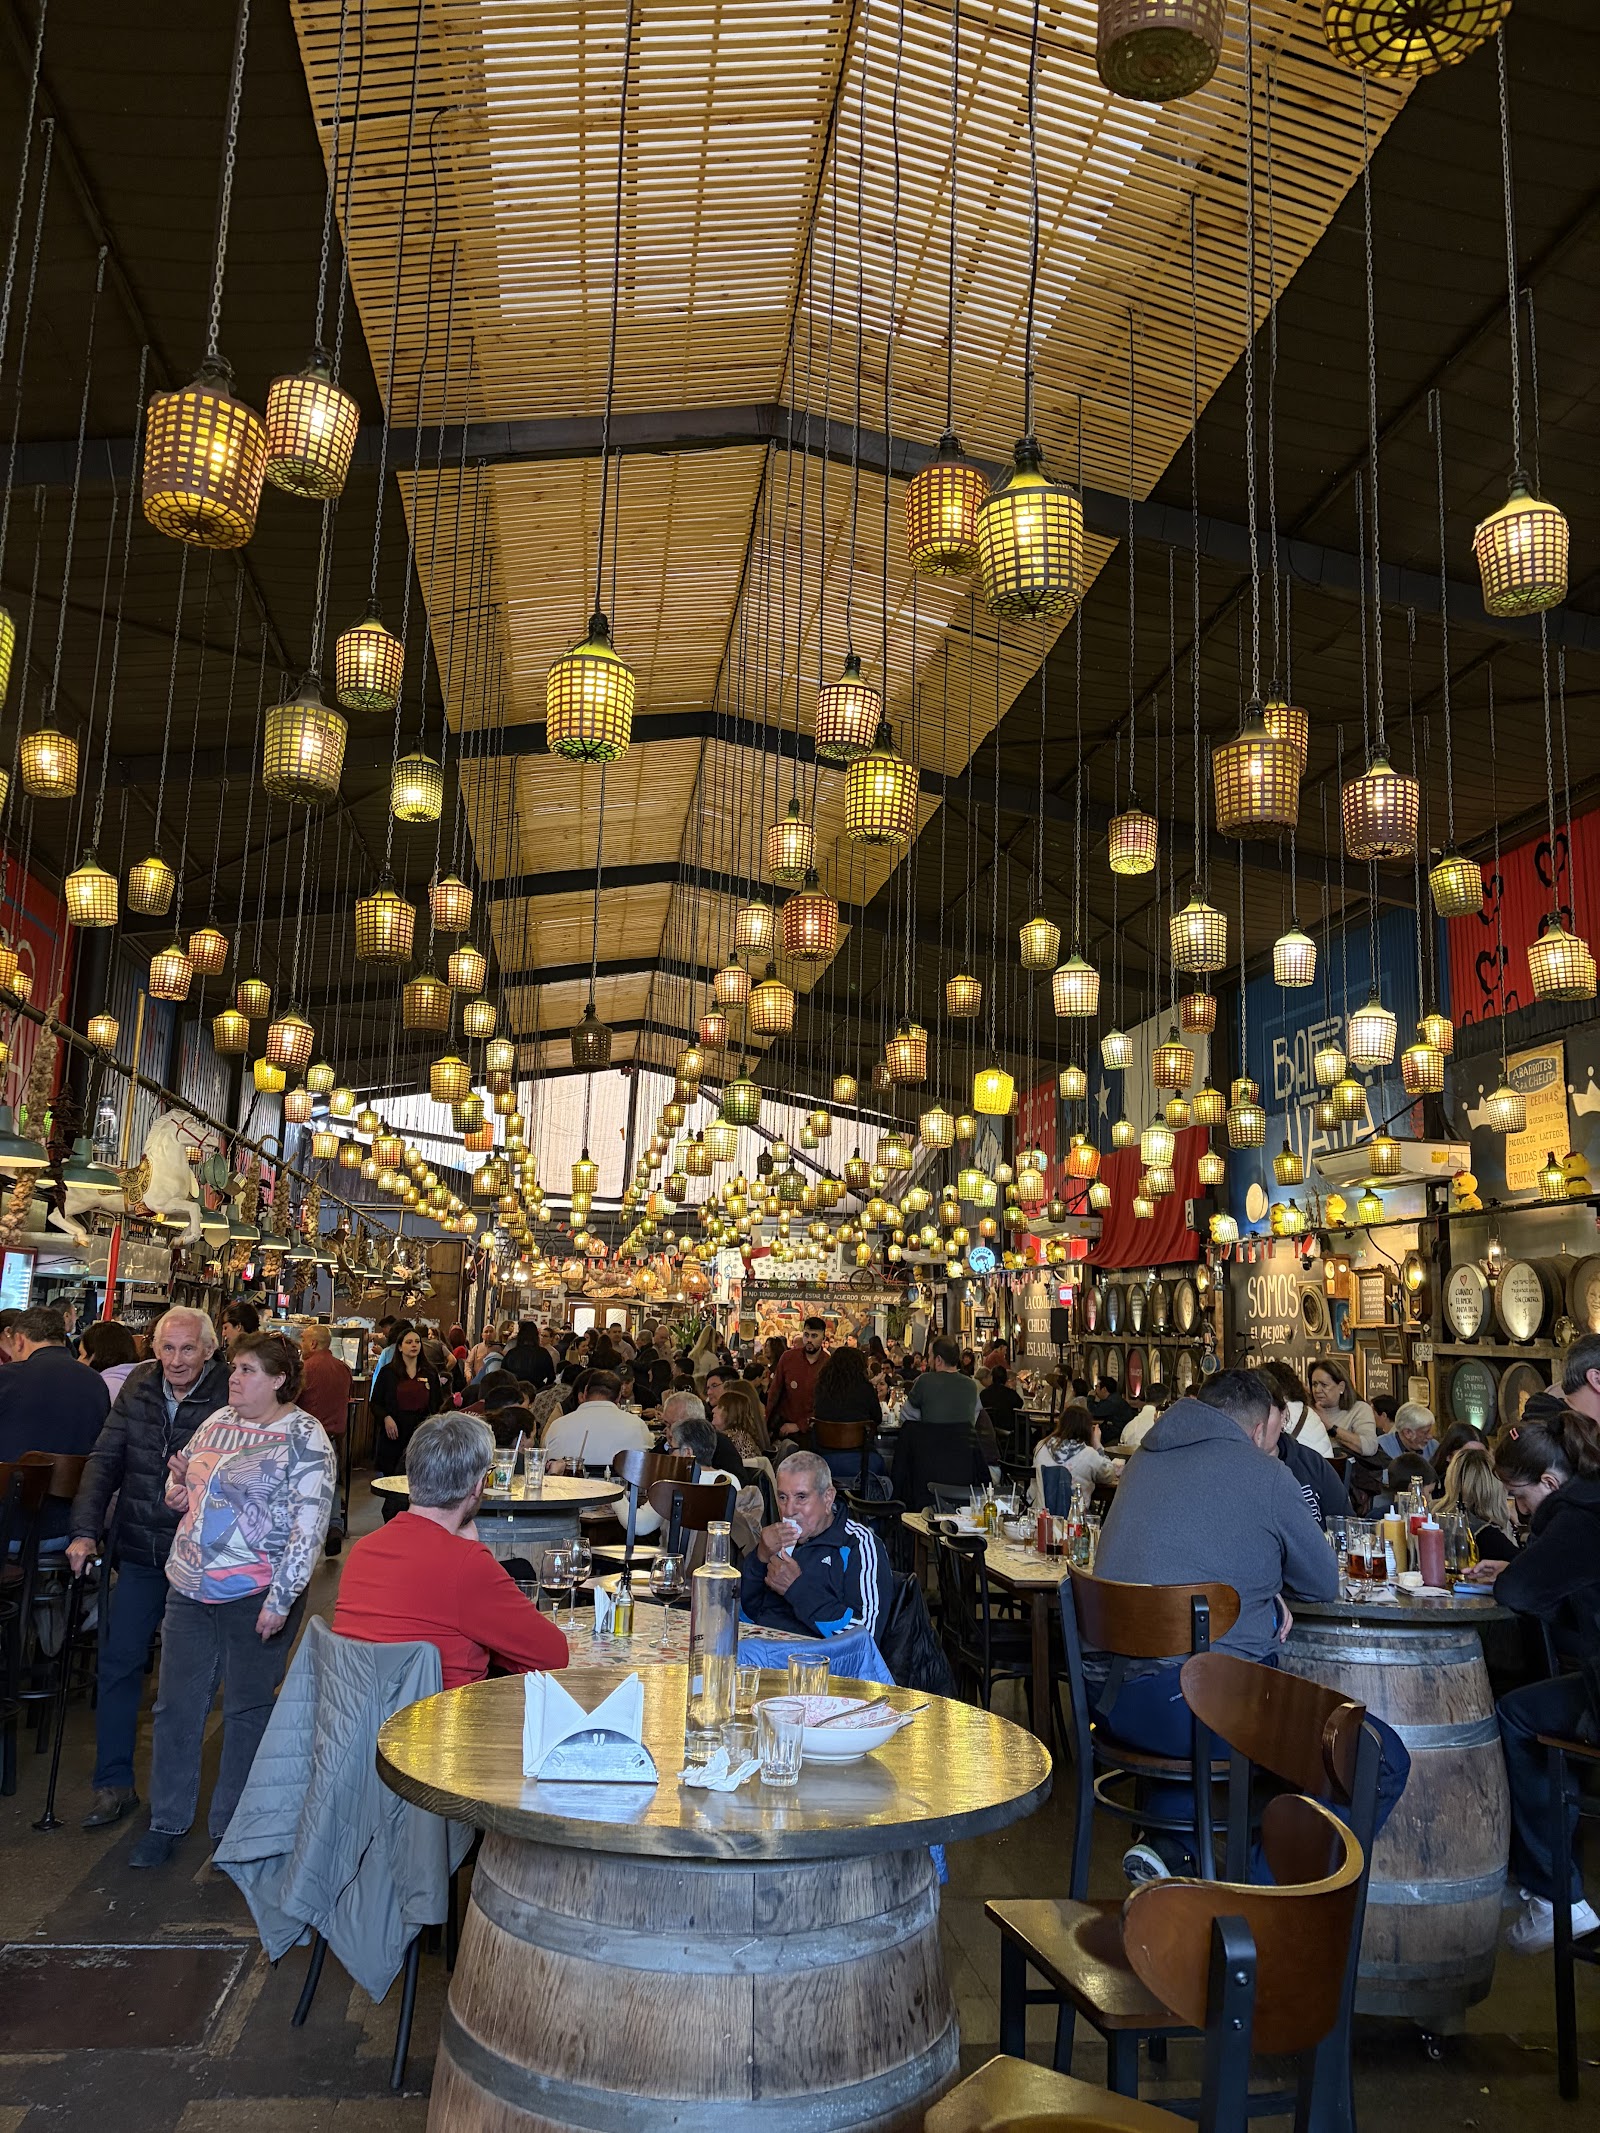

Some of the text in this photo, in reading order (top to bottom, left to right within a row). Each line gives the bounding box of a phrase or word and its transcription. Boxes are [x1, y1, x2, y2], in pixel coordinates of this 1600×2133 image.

[1512, 1058, 1553, 1080] ABARROTES
[1530, 1090, 1559, 1107] CECINAS
[1545, 1111, 1564, 1122] FRESCO
[1508, 1135, 1536, 1148] PRODUCTOS
[1508, 1150, 1538, 1166] BEBIDAS
[1508, 1169, 1536, 1186] FRUTAS
[860, 1294, 871, 1302] CON
[1247, 1273, 1299, 1319] SOMOS
[1455, 1288, 1474, 1296] CUANDO
[1027, 1318, 1051, 1333] CHILEN
[1261, 1324, 1285, 1345] MEJOR
